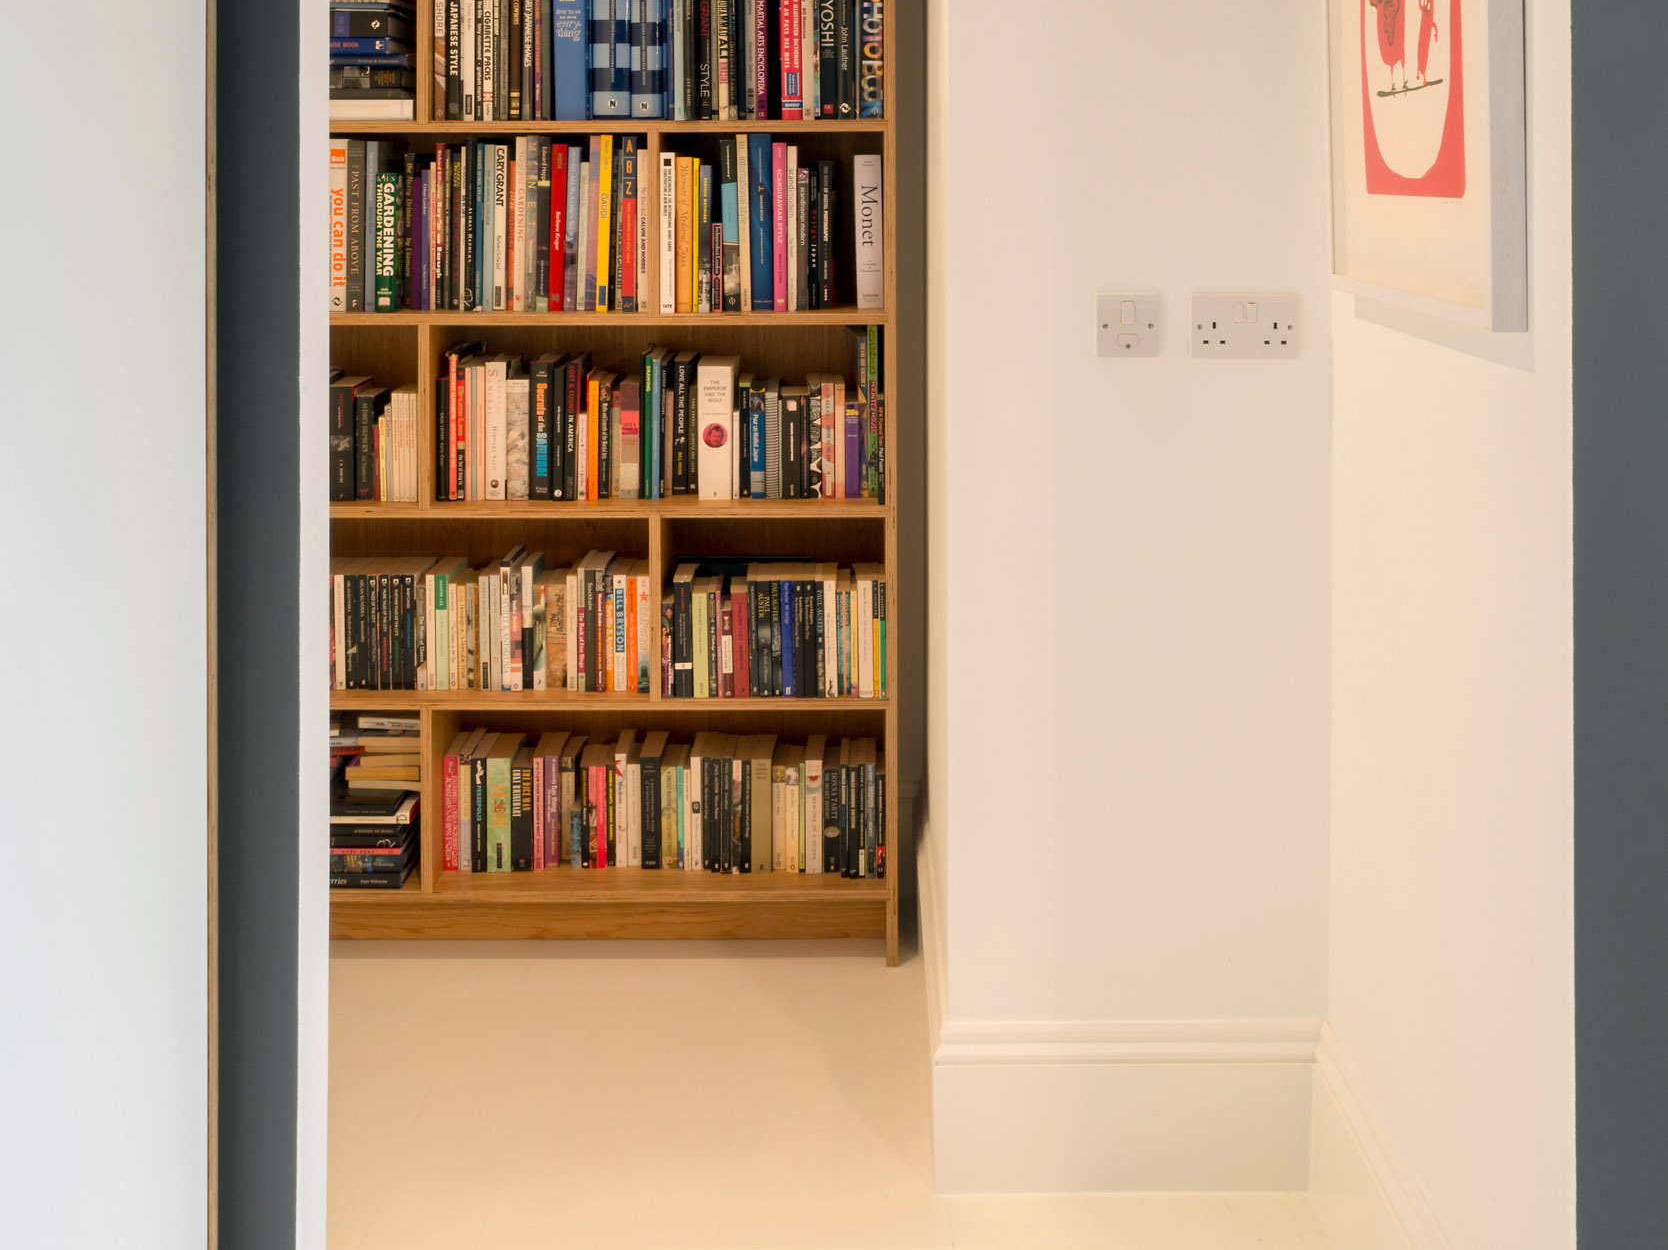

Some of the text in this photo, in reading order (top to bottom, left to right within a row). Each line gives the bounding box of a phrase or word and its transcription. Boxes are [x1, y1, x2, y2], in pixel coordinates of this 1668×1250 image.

[436, 2, 444, 34] SHORE
[700, 1, 709, 37] GRANT
[450, 2, 458, 76] JAPANESE STYLE
[719, 38, 727, 59] ALI
[701, 64, 709, 97] STYLE
[496, 148, 504, 206] CARY GRANT
[739, 156, 748, 224] international style
[351, 202, 359, 233] FROM
[383, 183, 394, 276] GARDENING
[861, 185, 878, 246] Monet
[333, 189, 346, 286] you can do it
[351, 238, 359, 274] ABOVE
[536, 383, 547, 415] Secrets
[537, 423, 546, 432] the
[568, 415, 574, 423] IN
[536, 433, 547, 477] SAMURAI
[616, 612, 624, 652] BRYSON
